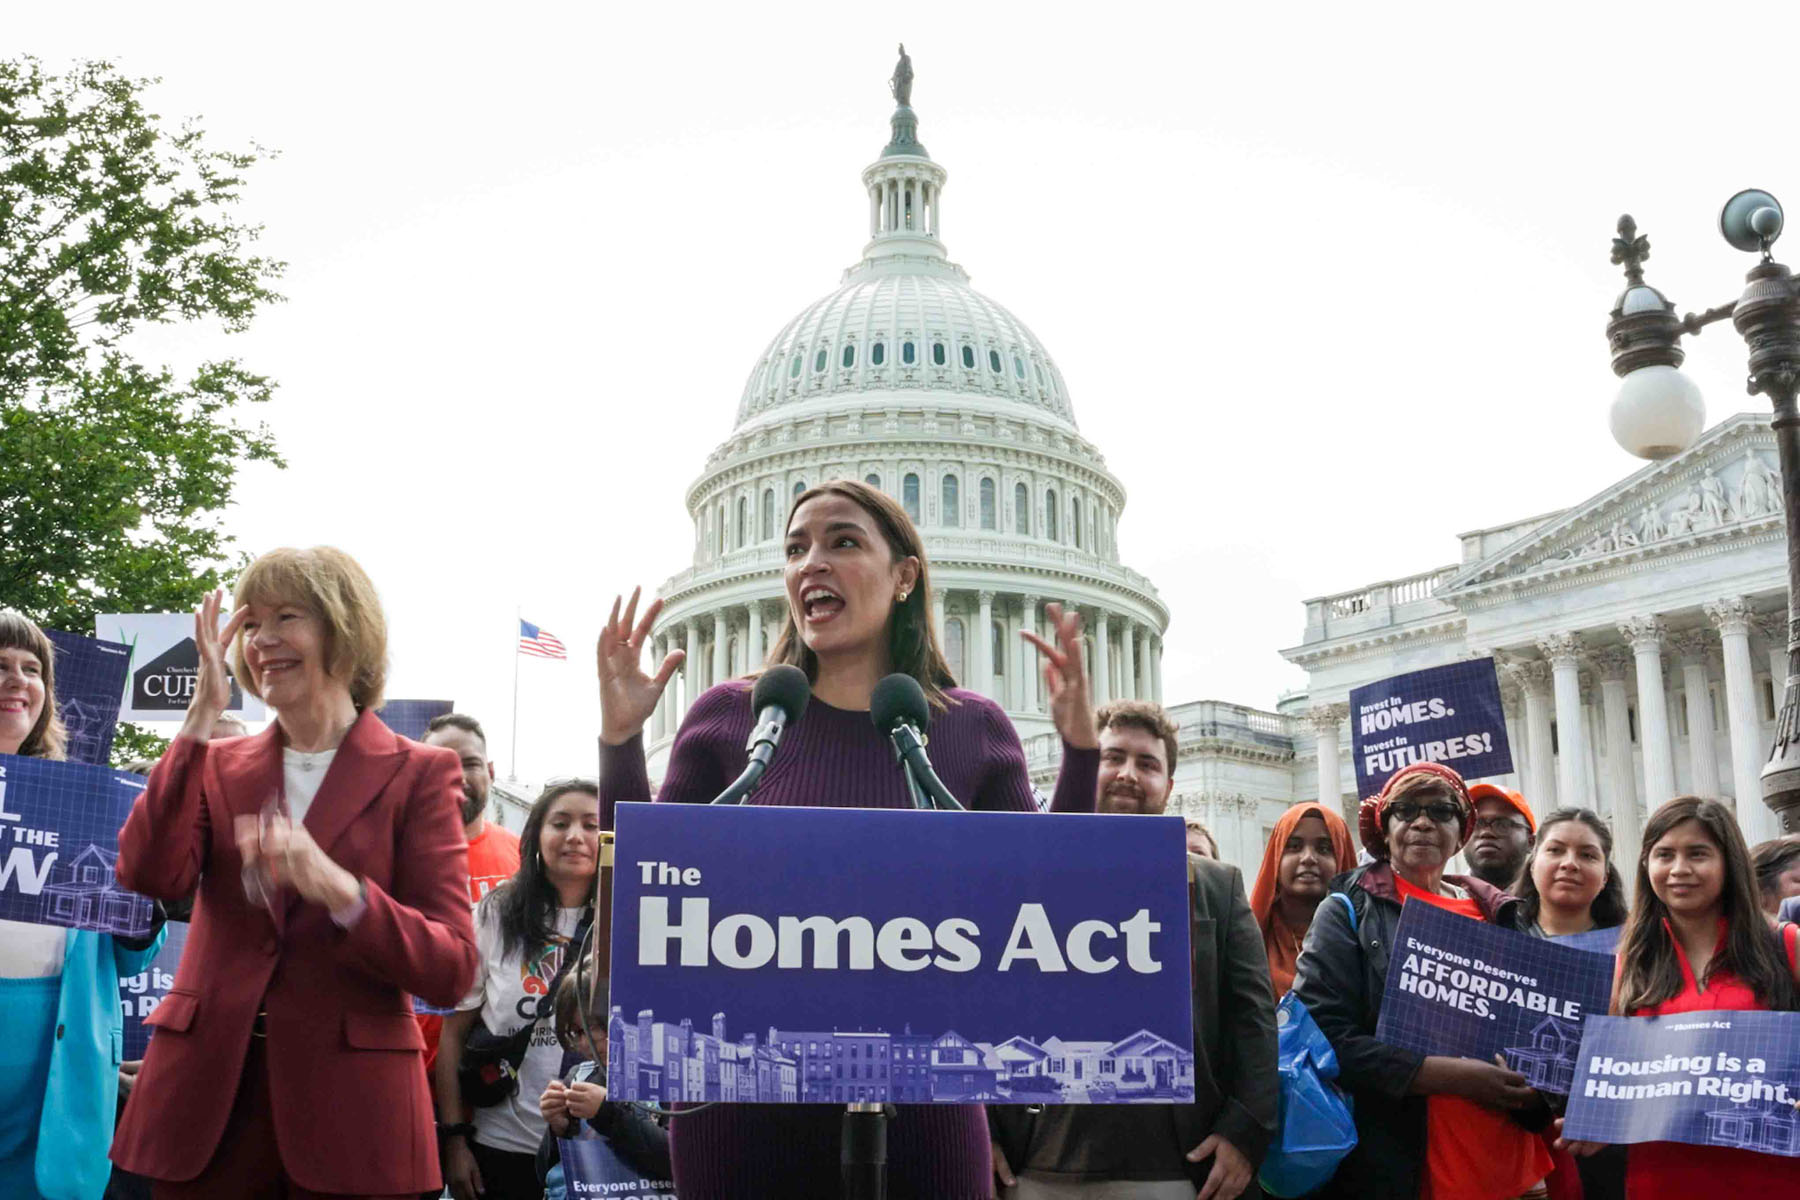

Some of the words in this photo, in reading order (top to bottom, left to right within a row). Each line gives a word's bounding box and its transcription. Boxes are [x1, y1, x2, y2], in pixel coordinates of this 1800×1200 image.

[1360, 701, 1390, 715] Invest
[1391, 697, 1402, 708] In
[1361, 698, 1455, 735] HOMES.
[1363, 741, 1394, 754] Invest
[1396, 737, 1407, 747] In
[1365, 732, 1493, 776] FUTURES!
[12, 826, 59, 848] THE
[637, 861, 701, 887] The
[638, 896, 981, 972] Homes
[998, 903, 1163, 974] Act
[1406, 937, 1471, 967] Everyone
[1473, 959, 1537, 988] Deserves
[153, 967, 174, 990] is
[1402, 953, 1581, 1021] AFFORDABLE
[1399, 972, 1496, 1021] HOMES.
[1712, 1020, 1731, 1029] Act
[1589, 1054, 1712, 1076] Housing
[1716, 1052, 1741, 1073] is
[1746, 1058, 1766, 1073] a
[1584, 1079, 1692, 1099] Human
[1697, 1076, 1796, 1105] Right.
[573, 1180, 637, 1195] Everyone
